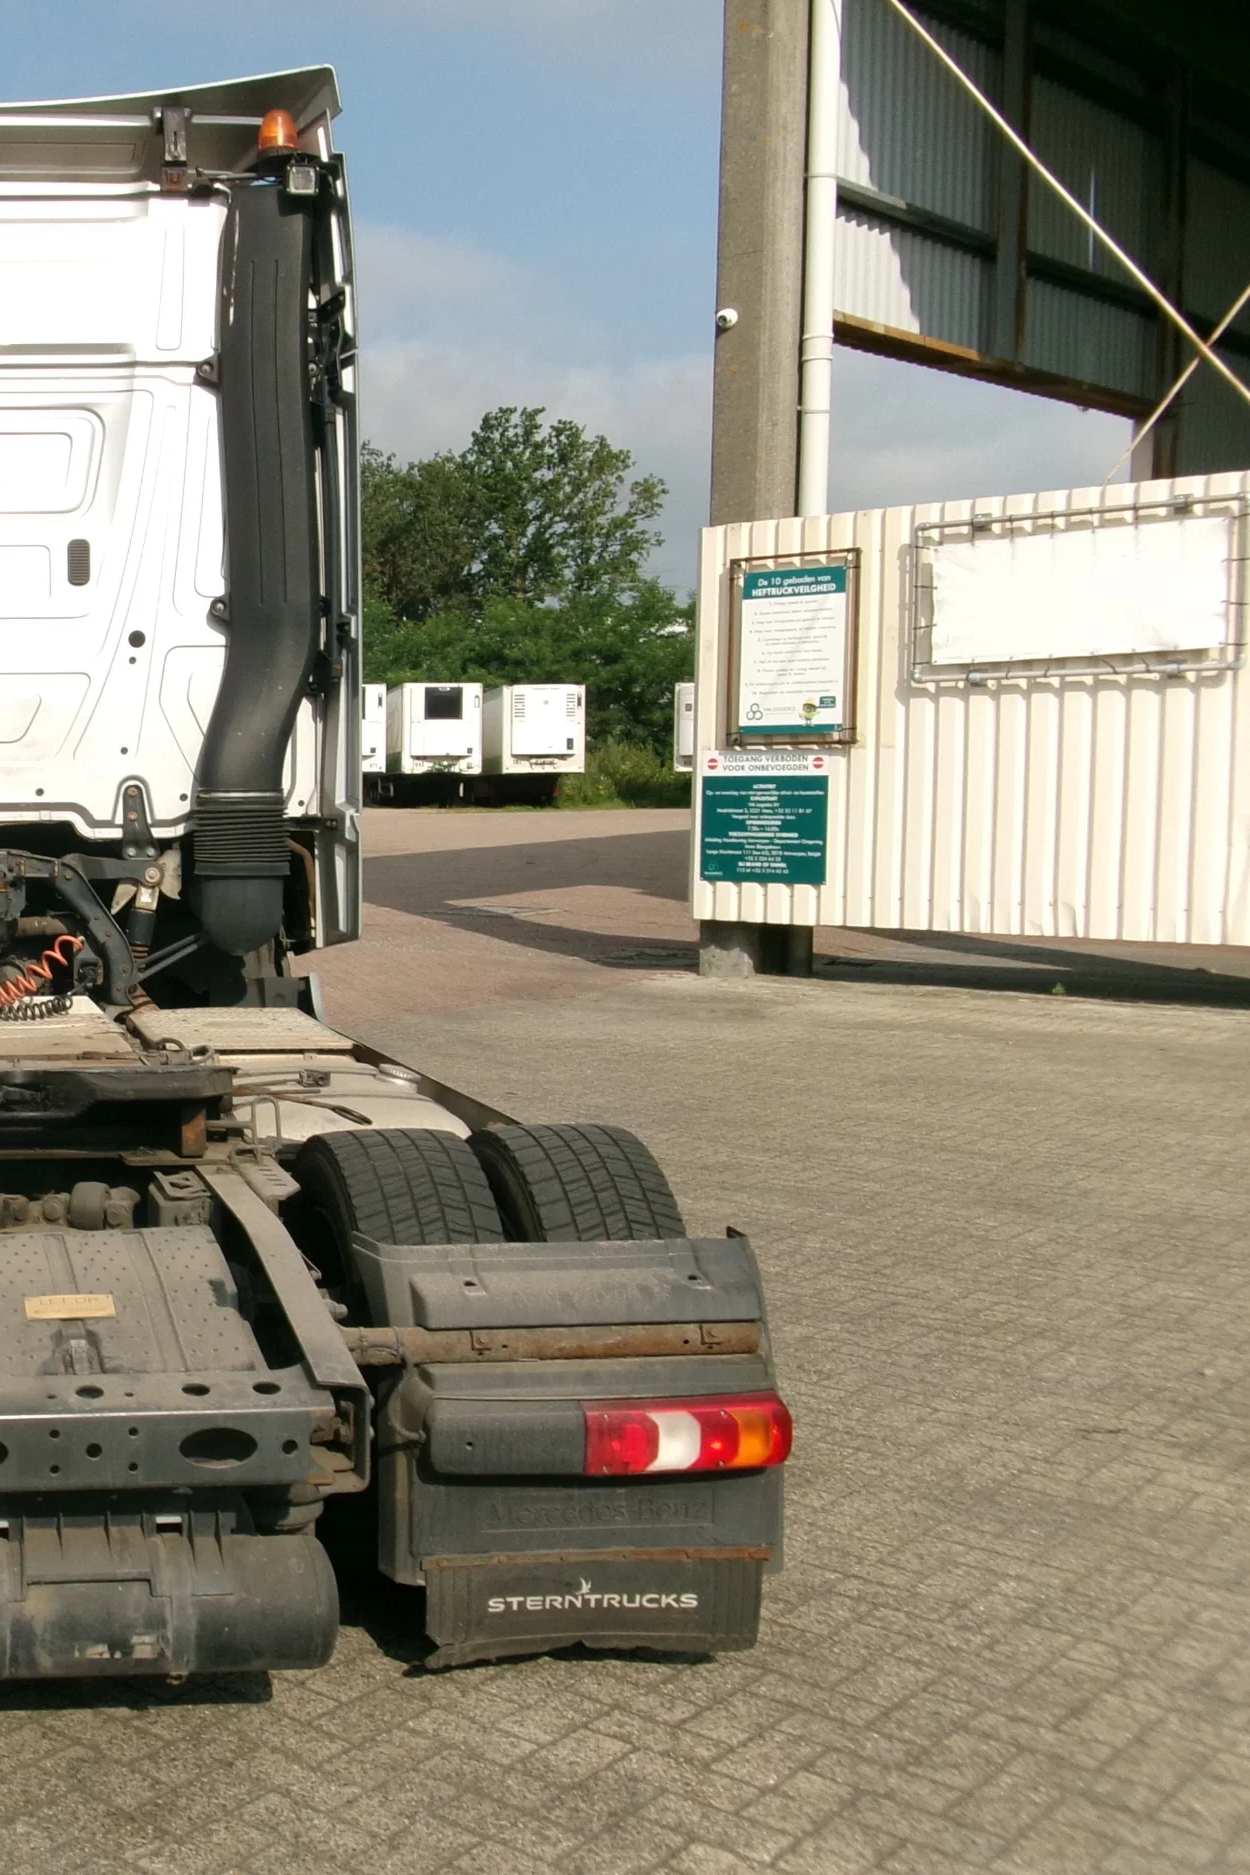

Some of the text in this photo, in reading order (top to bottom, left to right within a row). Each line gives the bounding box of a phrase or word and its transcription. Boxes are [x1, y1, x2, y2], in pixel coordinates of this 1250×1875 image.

[757, 575, 832, 587] De 10 geboden van
[723, 754, 809, 763] TOEGANG VERBODEN
[722, 763, 810, 772] VOOR ONBEVOEGDEN
